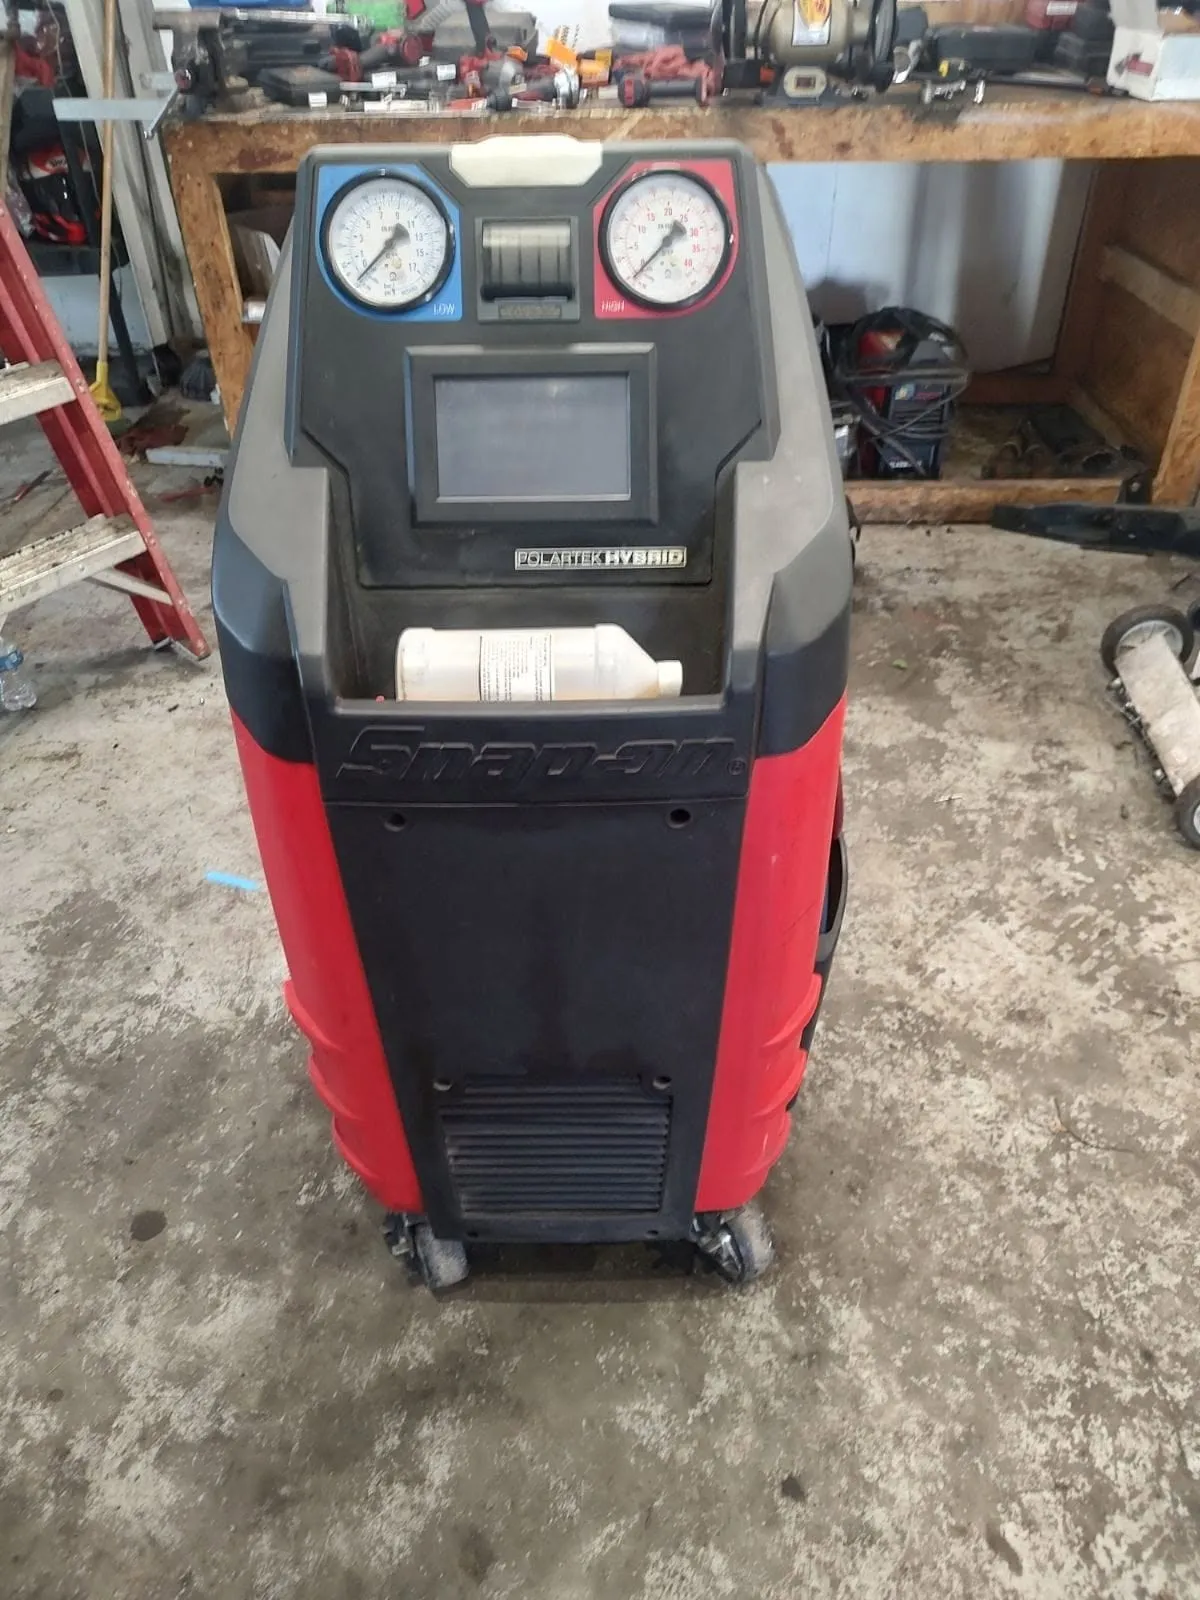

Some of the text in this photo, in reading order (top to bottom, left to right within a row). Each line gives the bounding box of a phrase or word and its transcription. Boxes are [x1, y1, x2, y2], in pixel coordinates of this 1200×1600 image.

[664, 208, 673, 217] 20
[647, 213, 656, 222] 15
[680, 214, 689, 223] 25
[407, 220, 415, 229] 11
[637, 225, 646, 234] 10
[690, 228, 699, 237] 30
[415, 233, 424, 242] 13
[416, 248, 425, 257] 15
[692, 244, 701, 253] 35
[684, 258, 693, 267] 40
[408, 263, 418, 272] 17
[433, 304, 455, 316] LOW
[601, 300, 625, 313] HIGH
[518, 549, 684, 567] POLARTEK HYBRID
[336, 724, 736, 786] Snap-on
